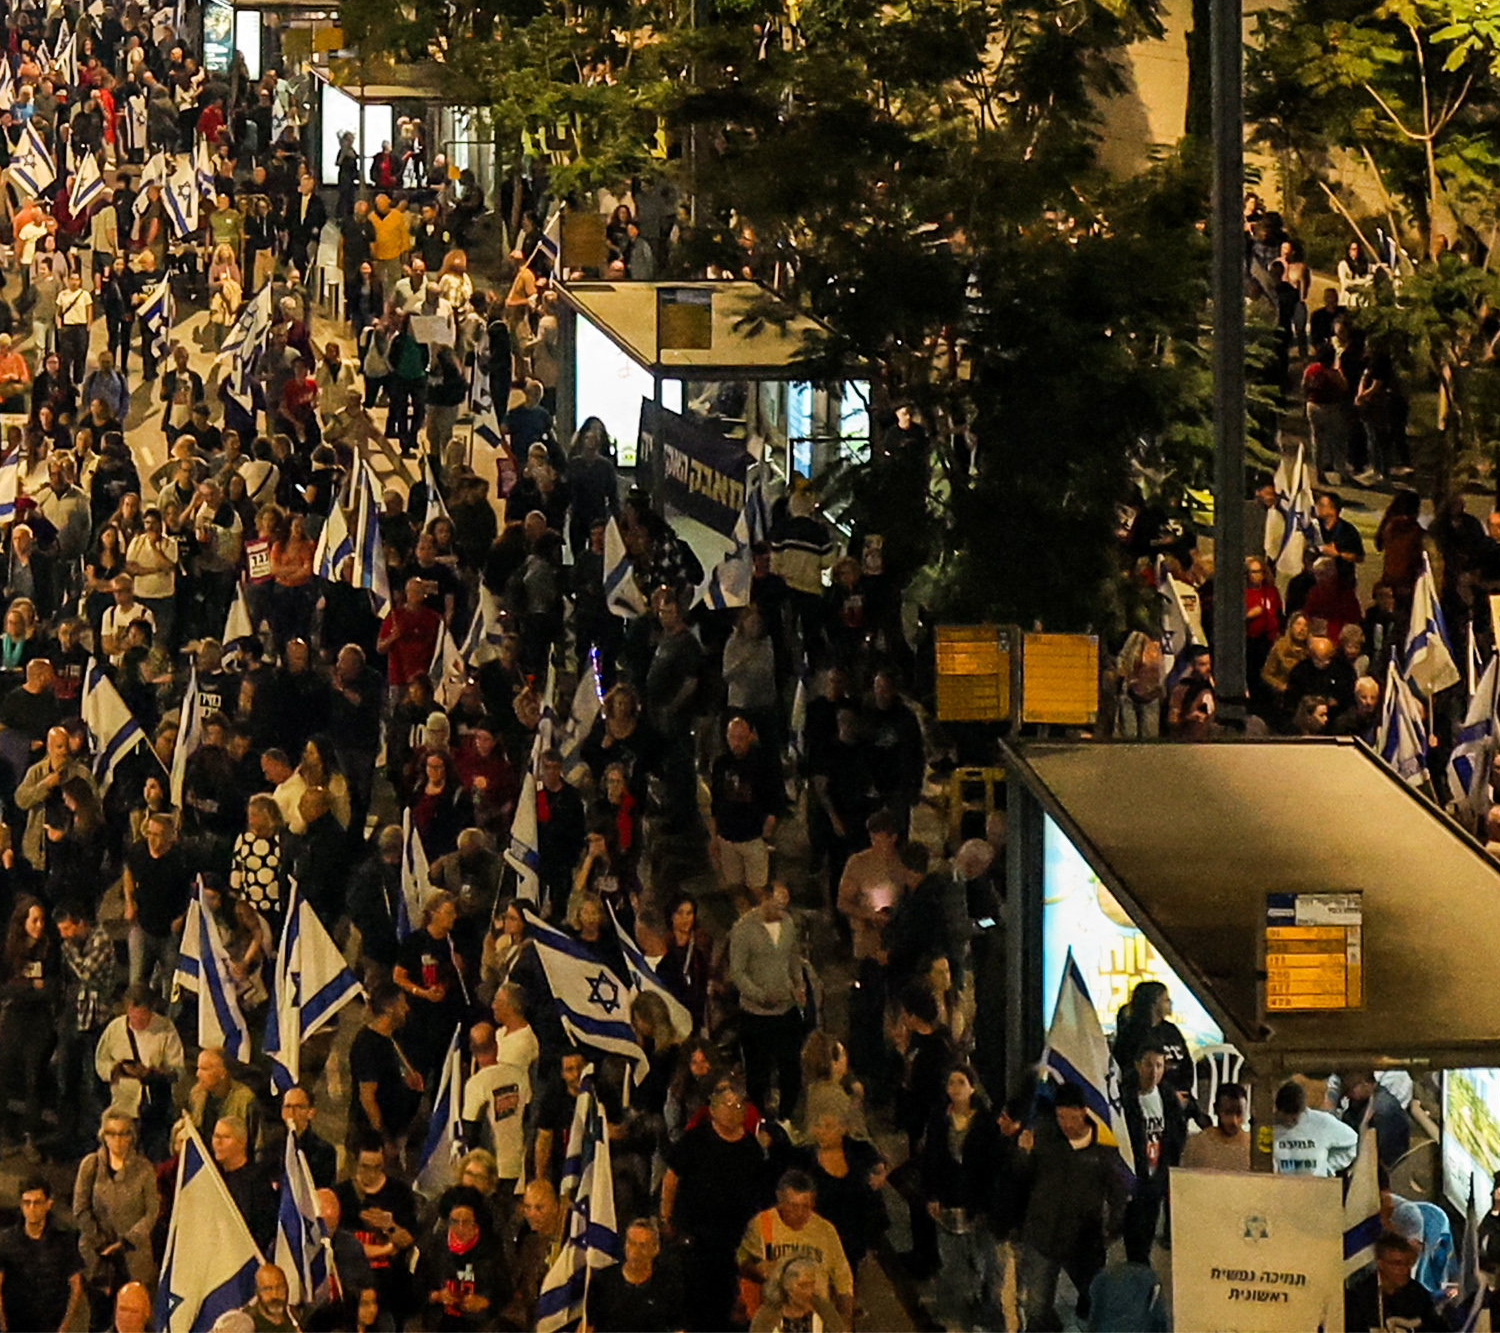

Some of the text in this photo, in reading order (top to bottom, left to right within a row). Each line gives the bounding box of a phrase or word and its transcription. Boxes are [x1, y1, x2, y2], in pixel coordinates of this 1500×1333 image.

[1210, 1266, 1307, 1287] תמיכה נפשית
[1228, 1287, 1289, 1304] ראשונית
